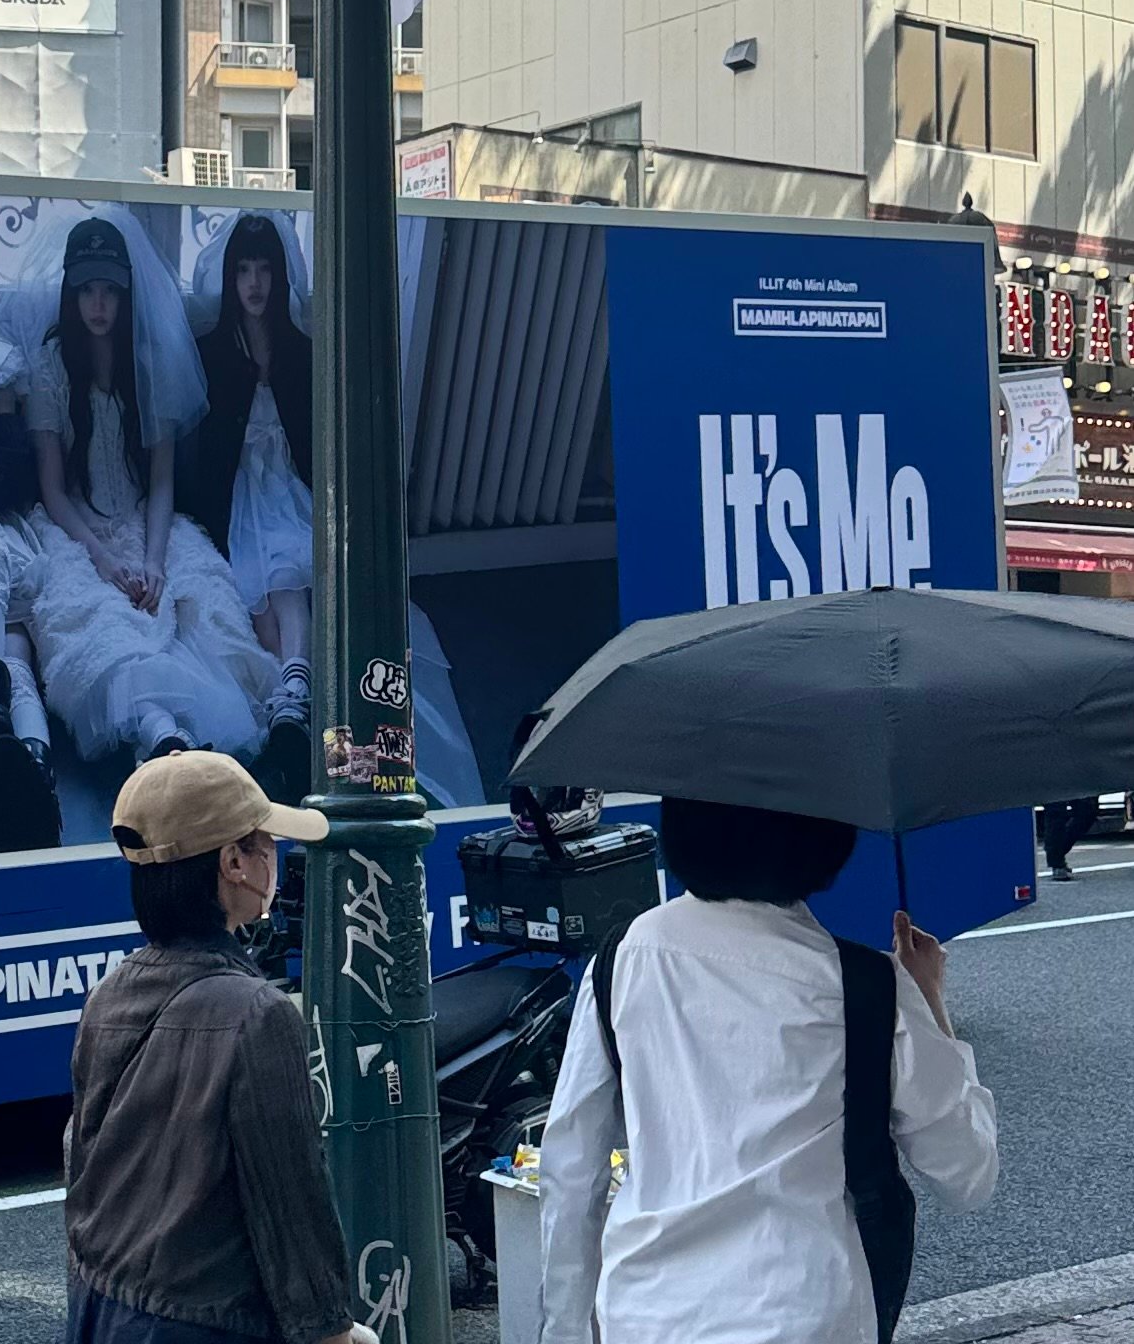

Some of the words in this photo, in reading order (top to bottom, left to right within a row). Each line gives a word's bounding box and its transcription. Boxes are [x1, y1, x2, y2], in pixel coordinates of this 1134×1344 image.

[758, 277, 785, 291] ILLIT
[785, 278, 803, 292] 4th
[804, 278, 826, 292] Mini
[826, 279, 859, 293] Album
[740, 308, 880, 329] MAMIHLAPINATAPAI
[699, 414, 811, 609] It's
[815, 413, 931, 598] Me
